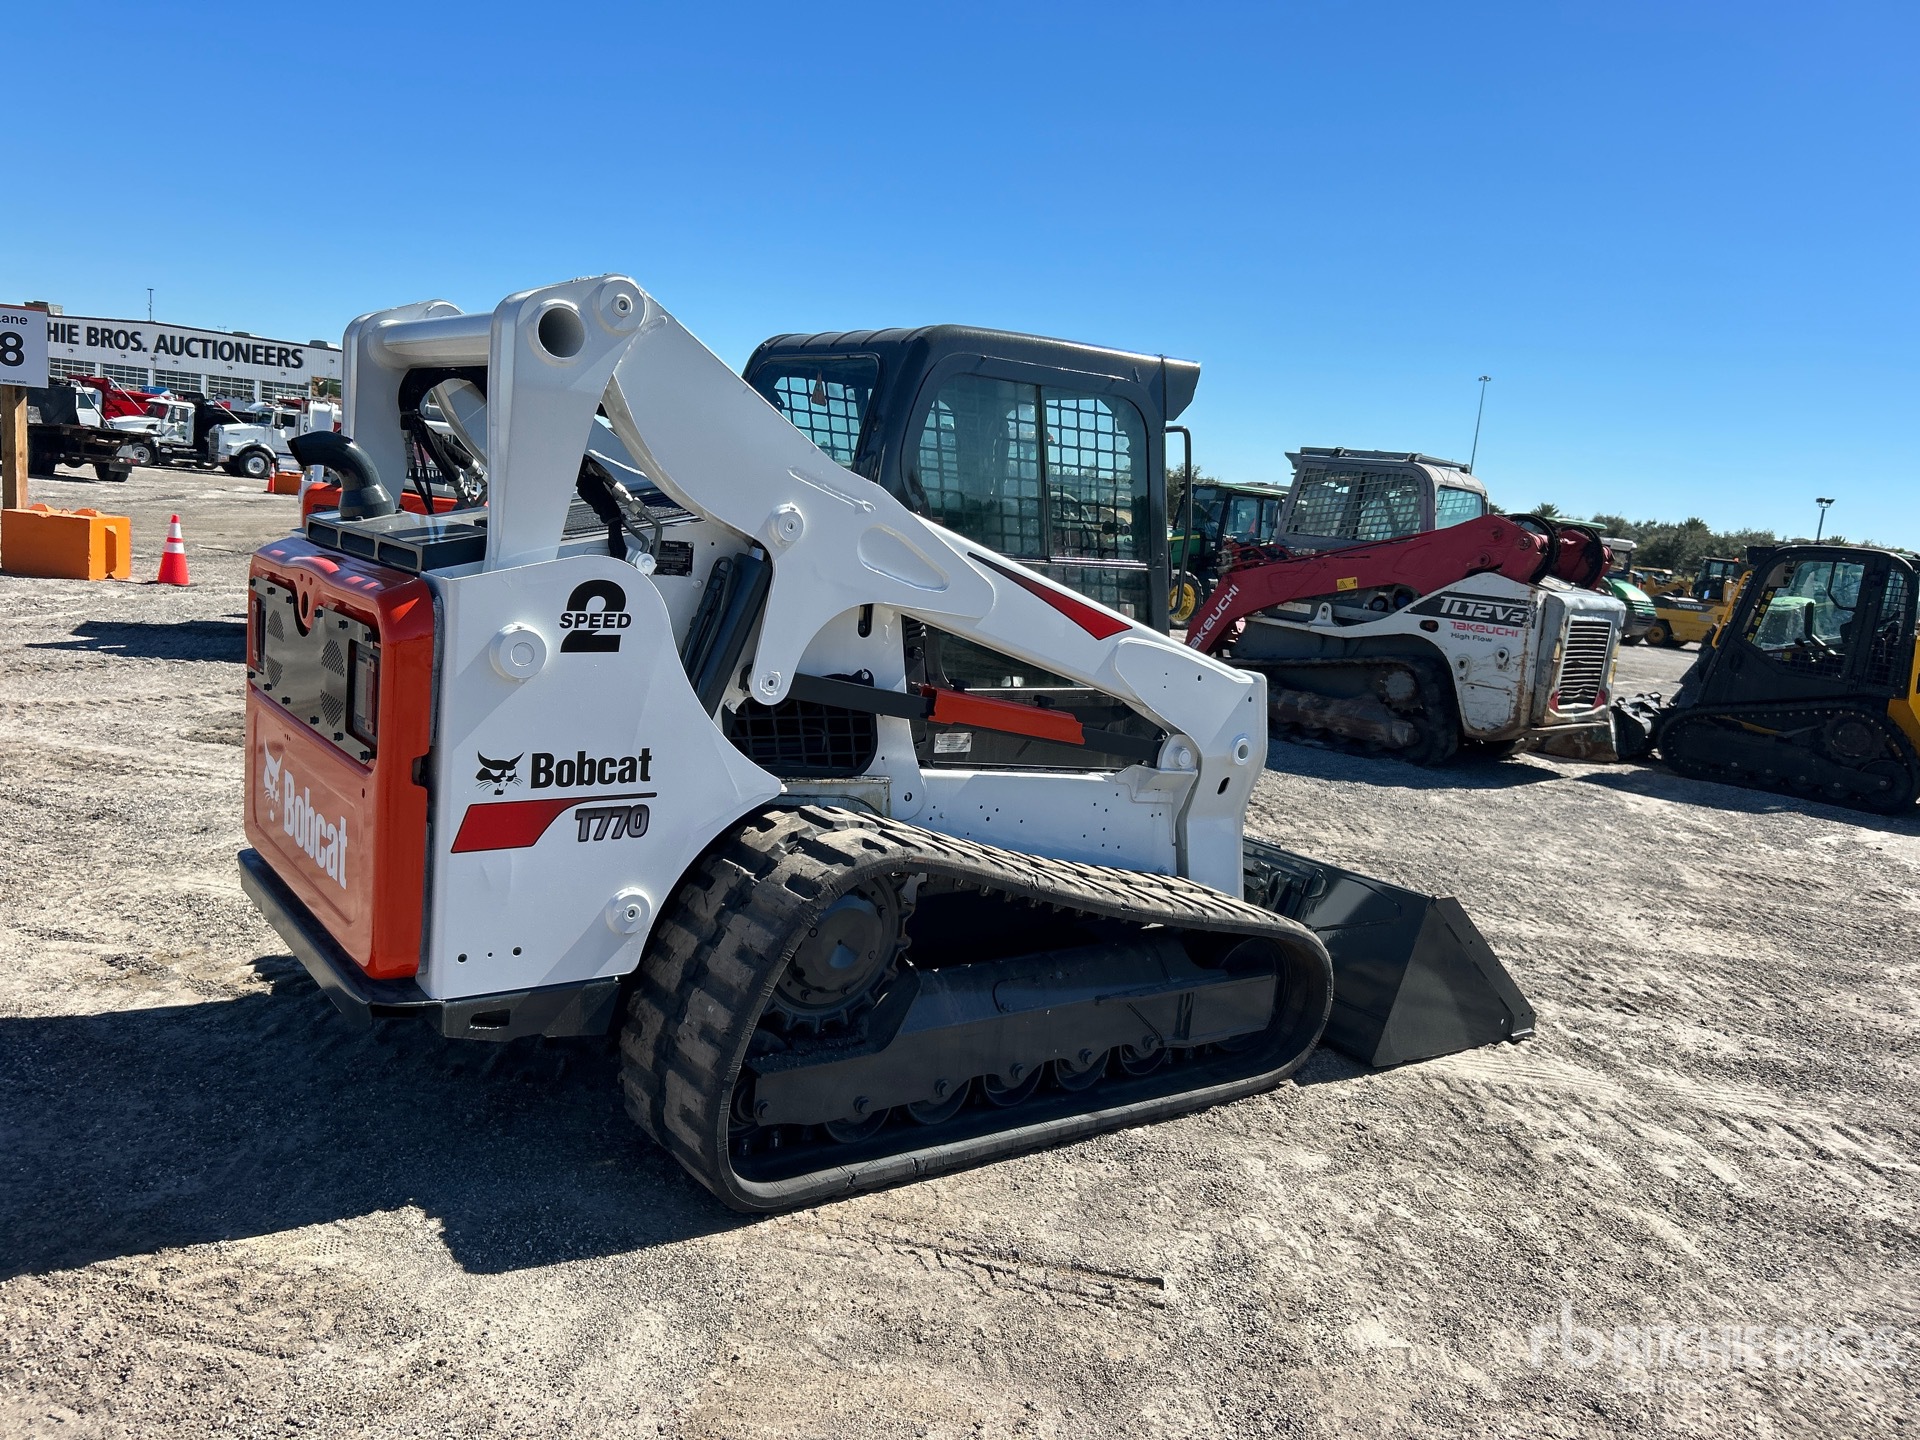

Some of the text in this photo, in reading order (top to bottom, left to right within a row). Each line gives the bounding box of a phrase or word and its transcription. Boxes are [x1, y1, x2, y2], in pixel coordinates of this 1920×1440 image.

[0, 314, 28, 325] ane
[0, 331, 24, 367] 8
[86, 326, 148, 353] BROS.
[153, 333, 304, 370] AUCTIONEERS
[559, 612, 632, 629] SPEED
[560, 579, 627, 653] 2
[1450, 632, 1493, 643] High Flow
[530, 747, 652, 789] Bobcat
[284, 769, 348, 890] Bobcat
[574, 803, 650, 843] T770
